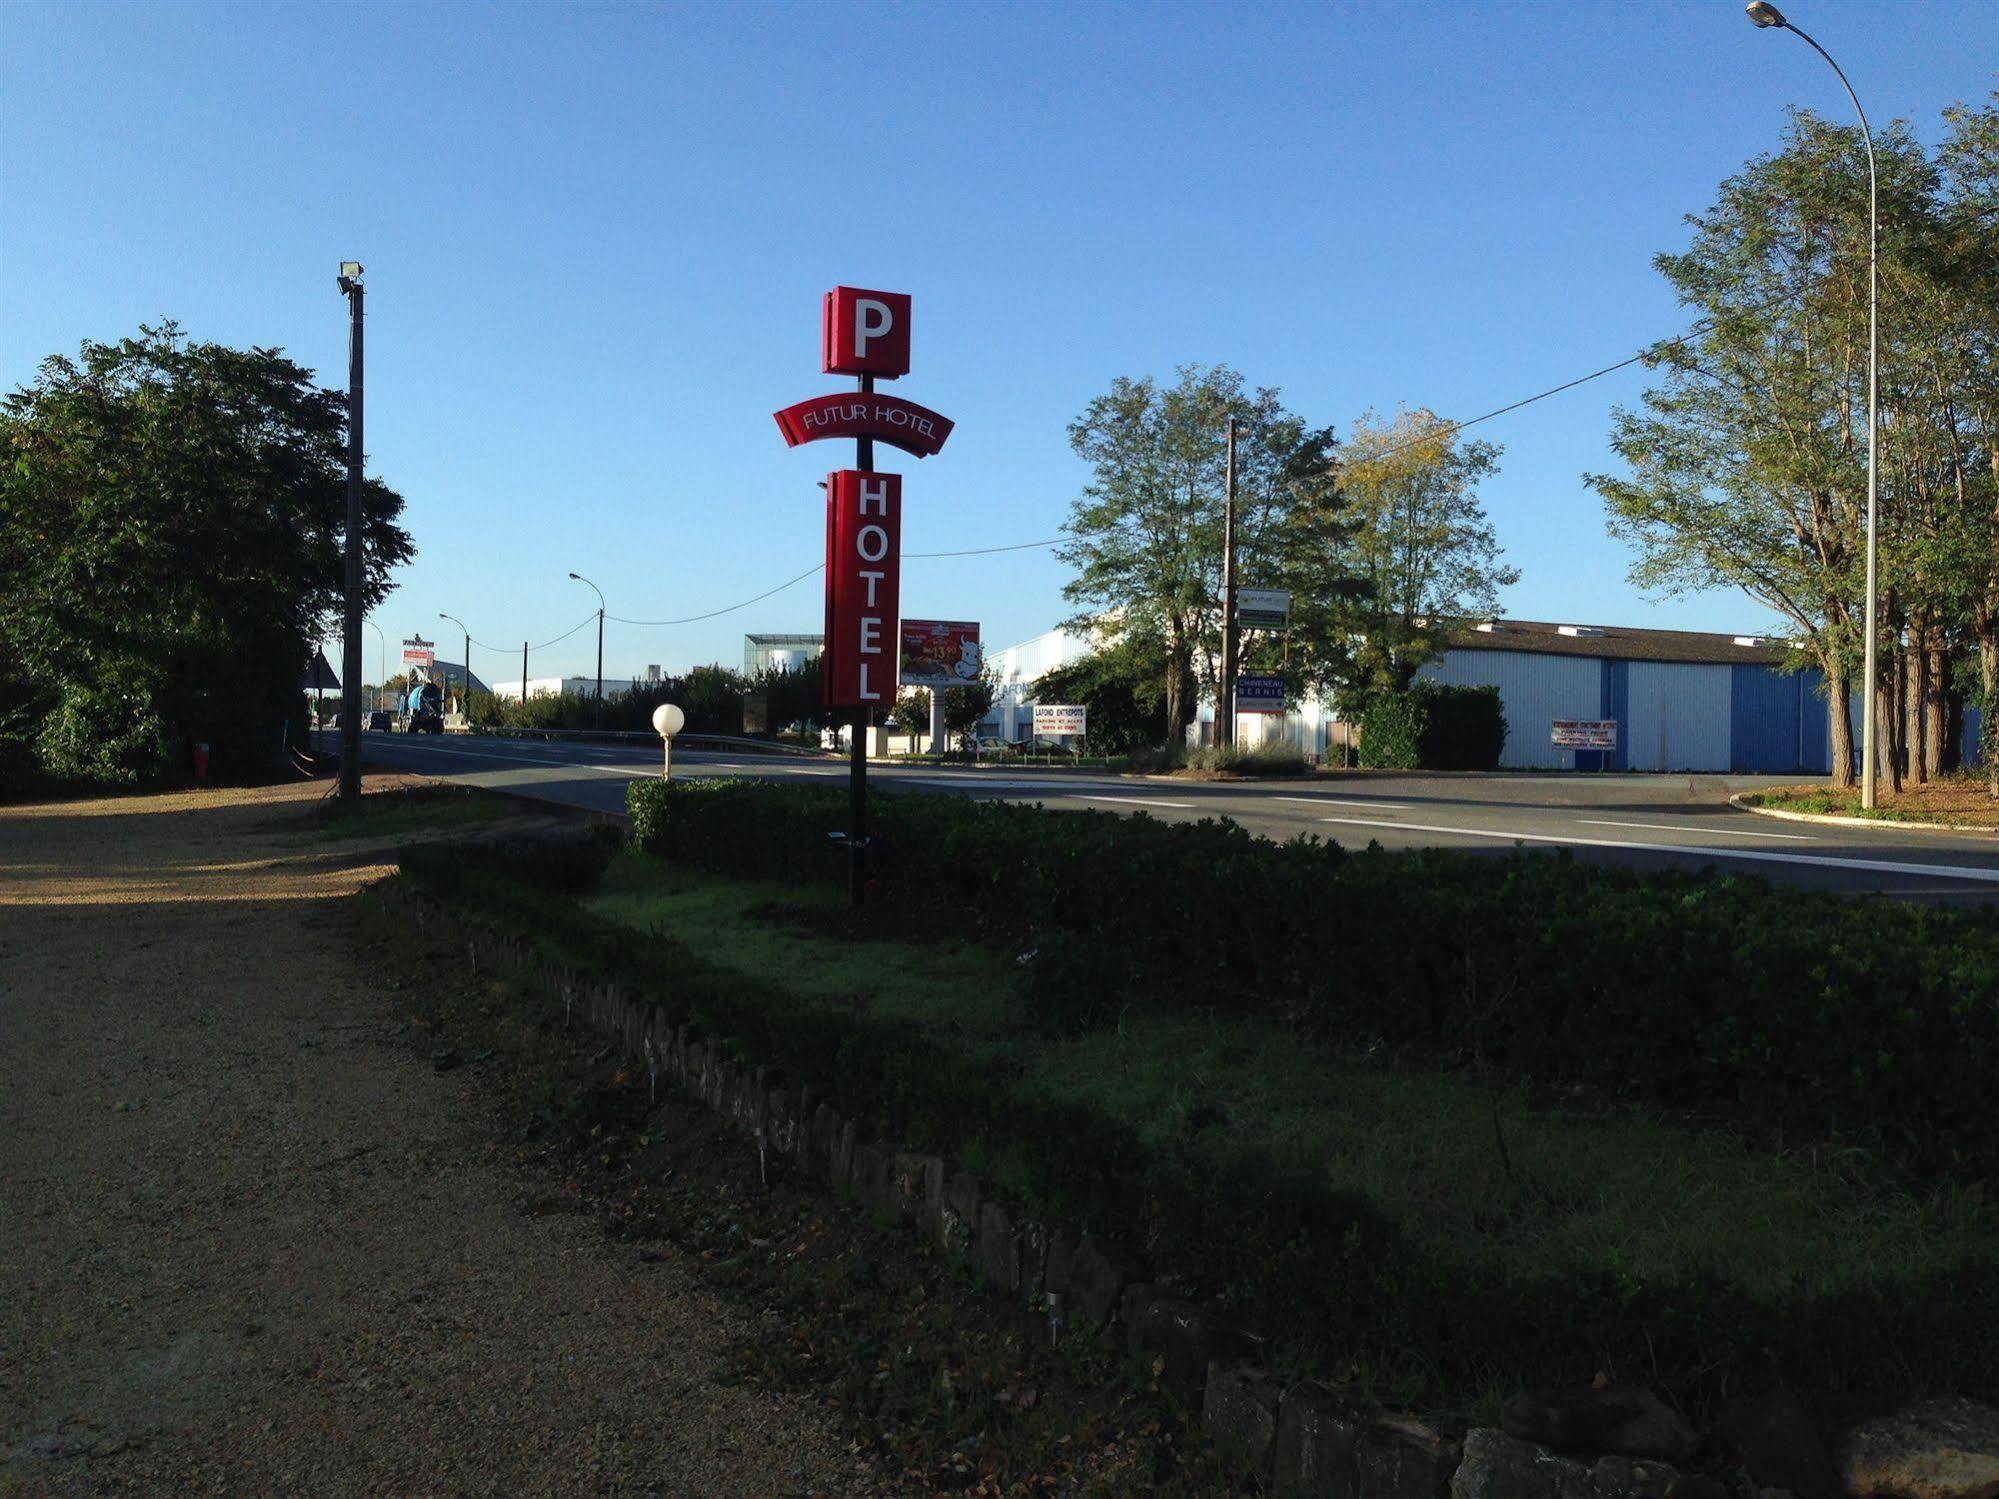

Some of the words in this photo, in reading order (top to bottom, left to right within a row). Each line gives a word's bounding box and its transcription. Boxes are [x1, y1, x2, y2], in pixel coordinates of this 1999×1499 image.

[855, 298, 893, 358] P
[802, 404, 867, 430] FUTUR
[875, 405, 936, 440] HOTEL
[856, 478, 889, 700] HOTEL
